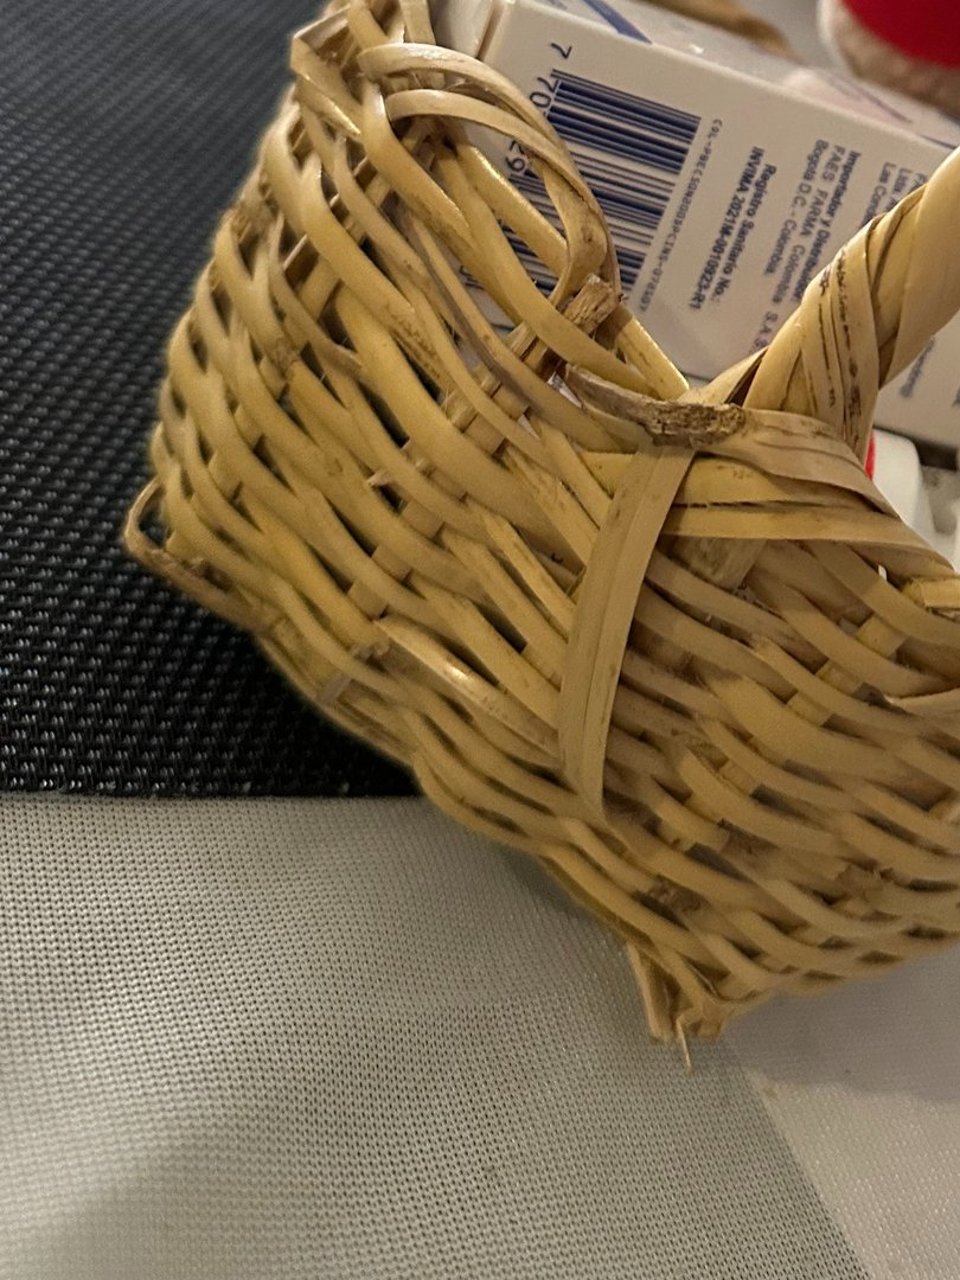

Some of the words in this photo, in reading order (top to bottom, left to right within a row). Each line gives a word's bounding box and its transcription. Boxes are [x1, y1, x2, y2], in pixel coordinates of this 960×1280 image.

[551, 42, 572, 60] 7
[737, 146, 765, 192] INVIMA
[823, 145, 845, 182] FAES
[827, 151, 861, 217] Importador
[747, 164, 777, 217] Registro
[801, 188, 828, 236] FARMA
[724, 221, 754, 274] Sanitario
[773, 244, 805, 303] Colombia
